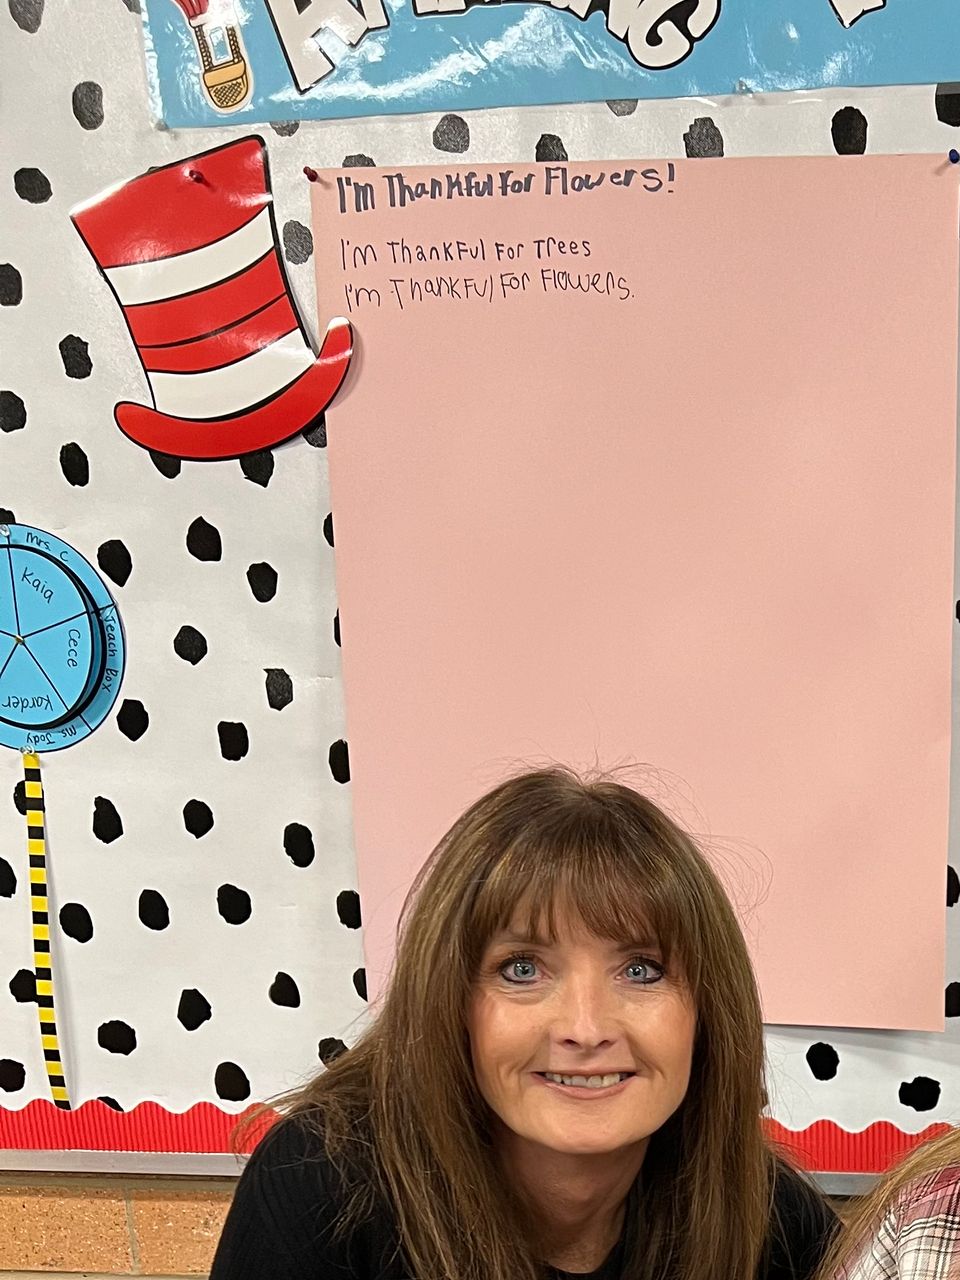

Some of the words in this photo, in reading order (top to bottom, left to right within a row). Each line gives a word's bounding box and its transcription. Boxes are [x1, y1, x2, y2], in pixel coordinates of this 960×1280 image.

[336, 175, 376, 213] I'm
[544, 163, 675, 196] Flowers!
[341, 238, 377, 270] I'm
[533, 237, 592, 259] Trees
[345, 284, 381, 313] I'm
[60, 551, 69, 561] C
[21, 566, 54, 604] Kaia
[67, 628, 81, 668] Cece
[102, 668, 119, 693] Box
[1, 695, 54, 713] Karder
[26, 732, 56, 745] Jody
